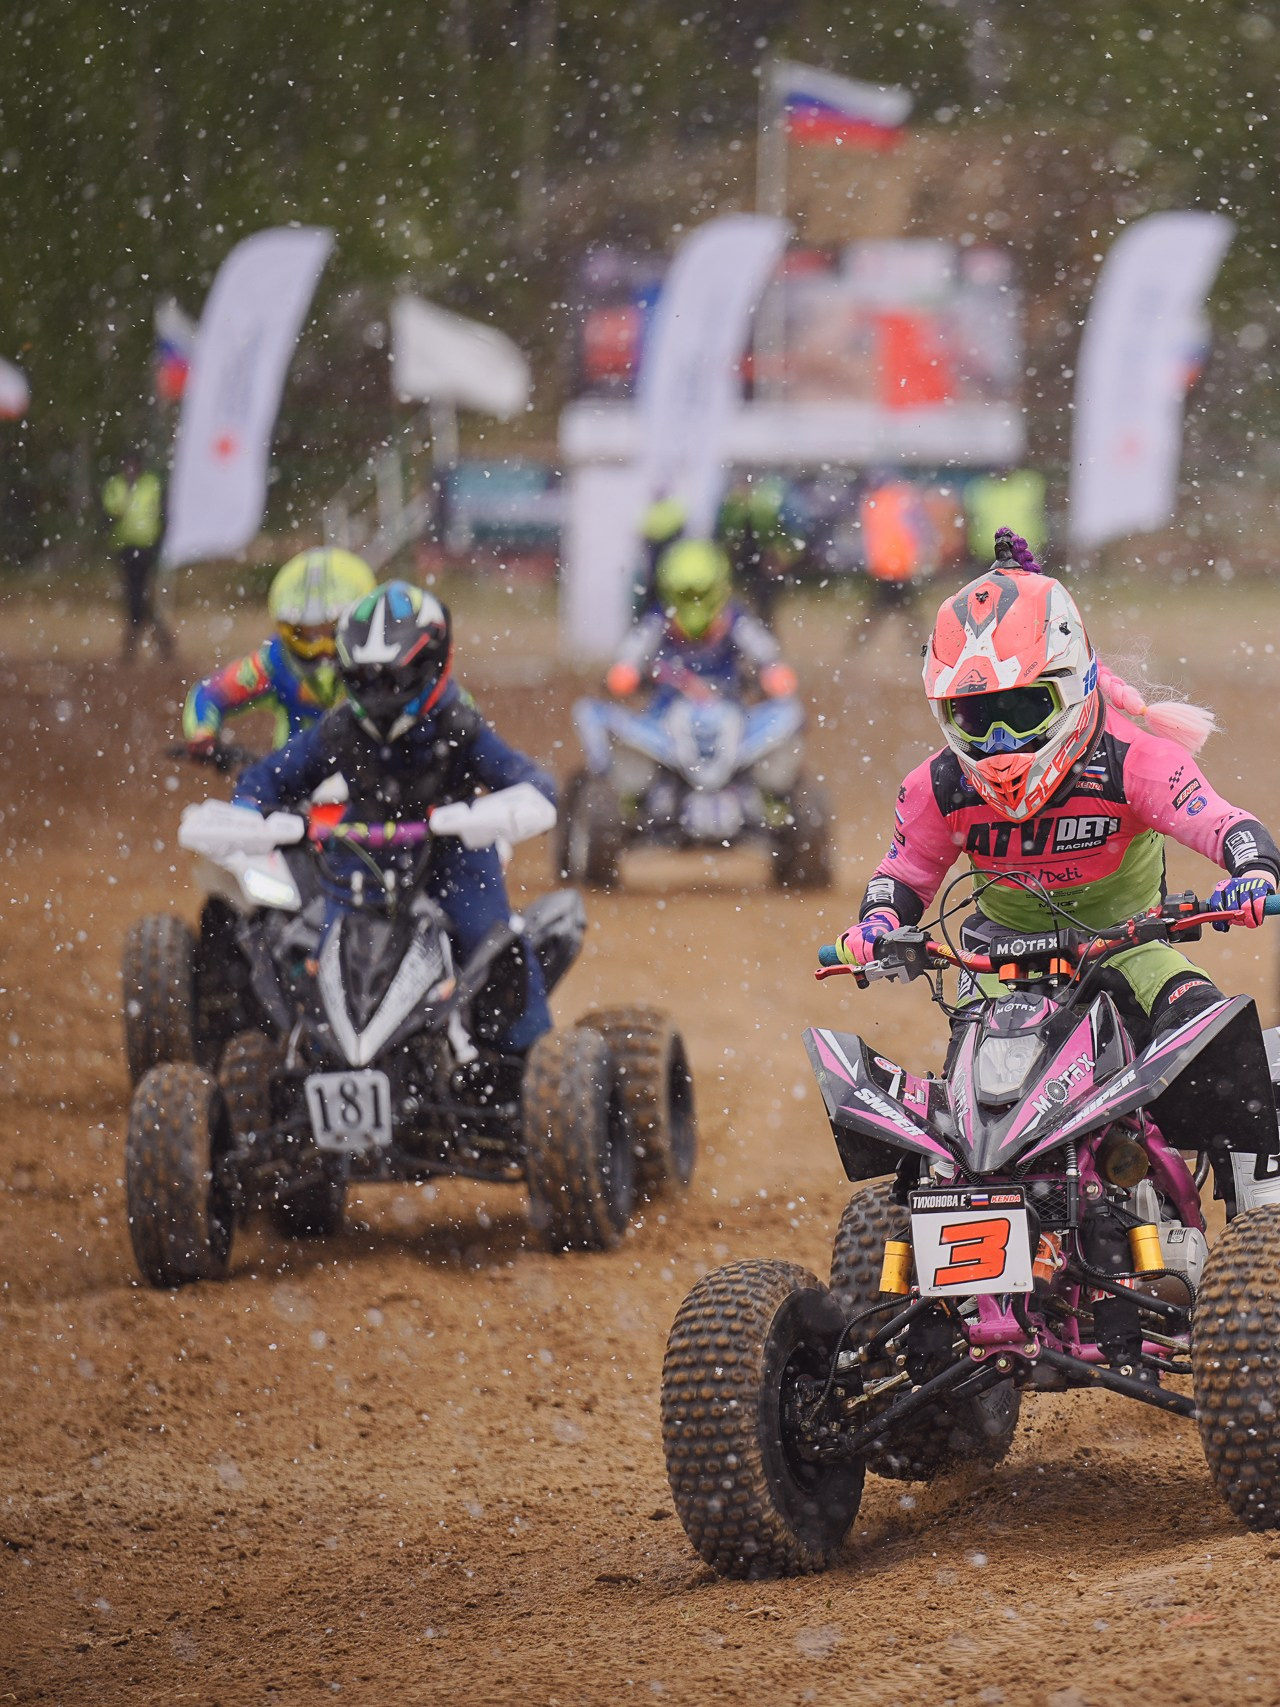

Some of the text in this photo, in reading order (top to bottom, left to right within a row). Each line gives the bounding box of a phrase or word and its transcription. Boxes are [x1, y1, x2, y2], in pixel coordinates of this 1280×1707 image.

[965, 816, 1055, 857] ATV
[1056, 840, 1102, 851] RACING
[315, 1080, 383, 1131] 181
[854, 1088, 926, 1136] SNIPER
[1061, 1070, 1136, 1132] SNIPER
[912, 1195, 959, 1209] ТИХОНОВА
[991, 1194, 1021, 1203] KENDA
[933, 1217, 1011, 1287] 3
